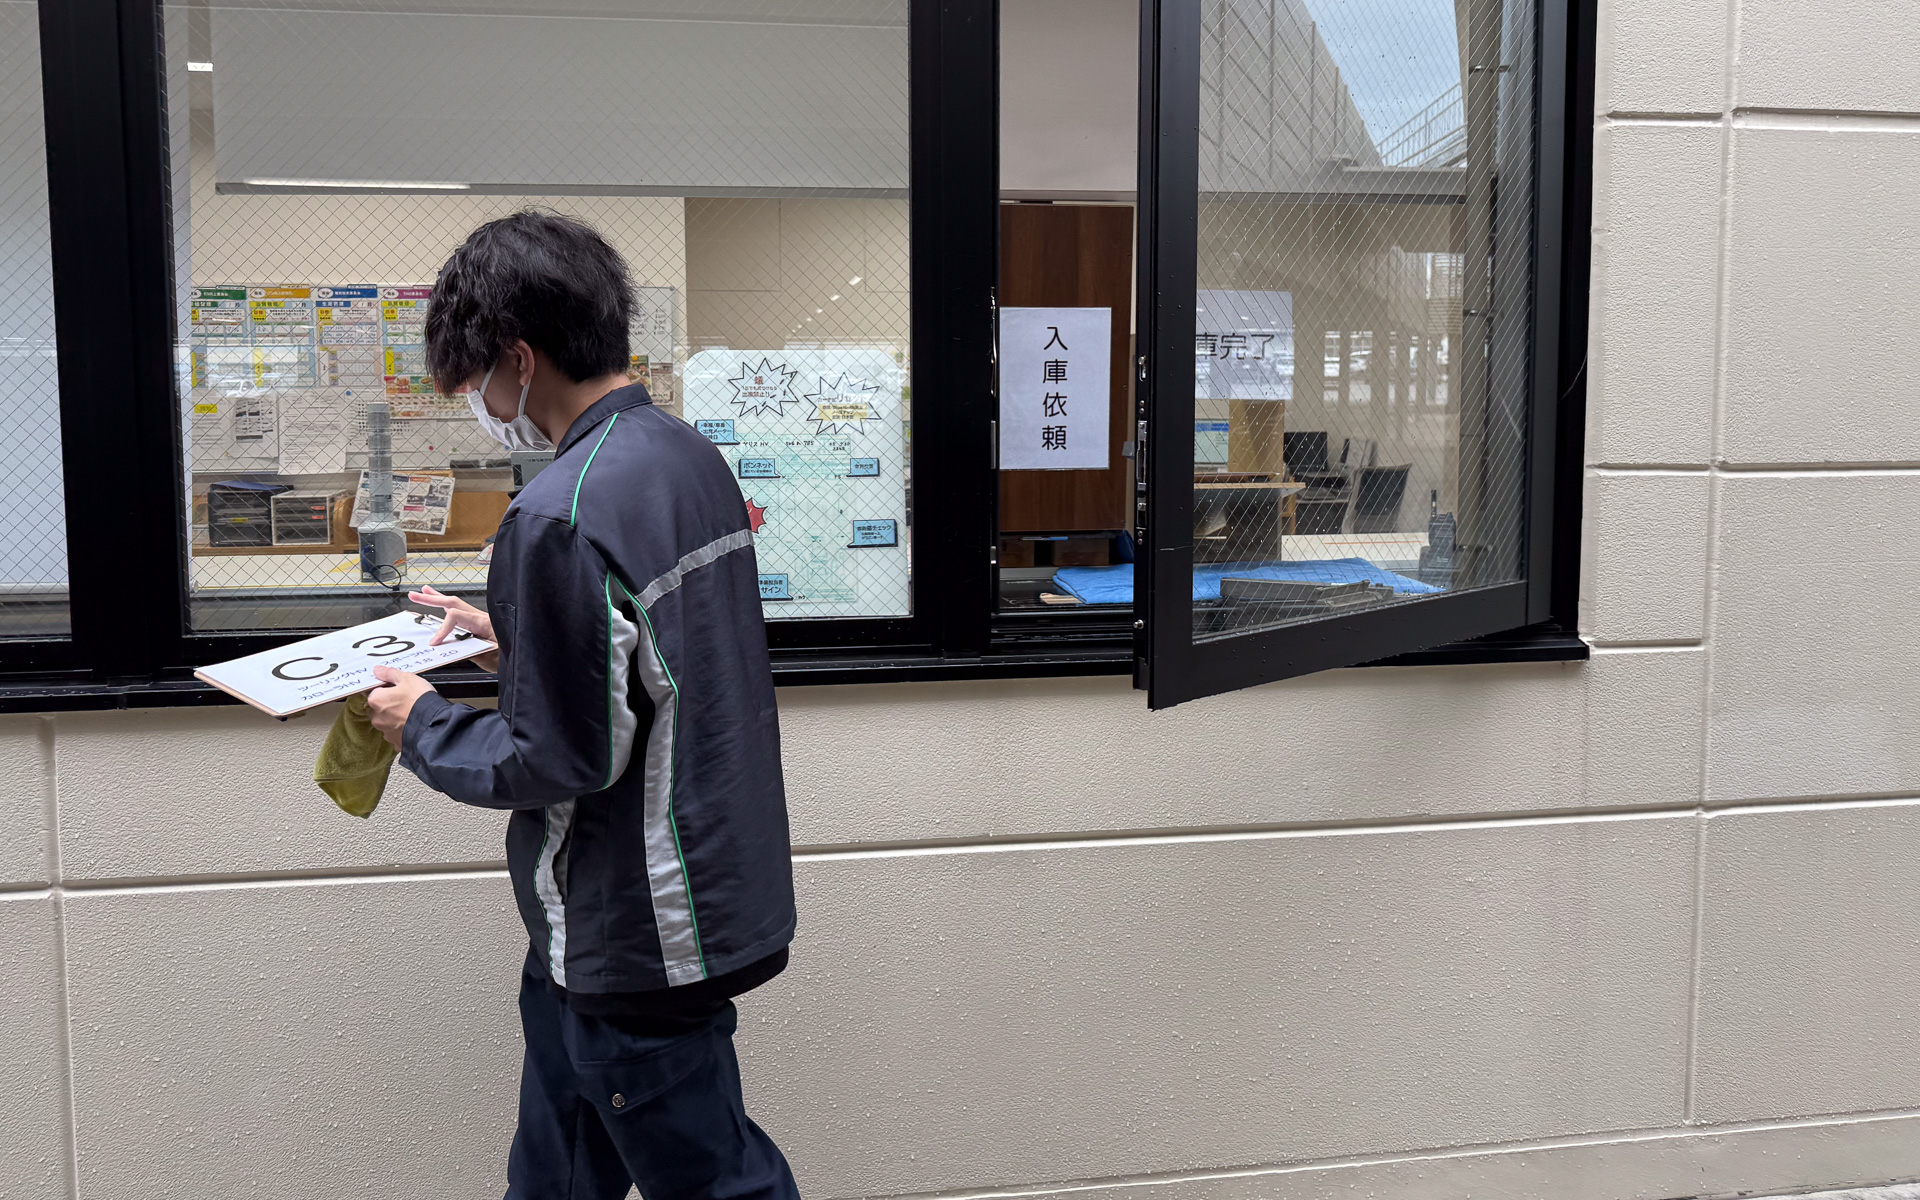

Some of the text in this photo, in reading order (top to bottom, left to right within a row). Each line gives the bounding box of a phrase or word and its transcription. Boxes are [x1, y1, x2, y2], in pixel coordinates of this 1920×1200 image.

[1042, 326, 1069, 451] 入庫依頼
[761, 586, 782, 594] サイン
[301, 679, 361, 701] カローラHV
